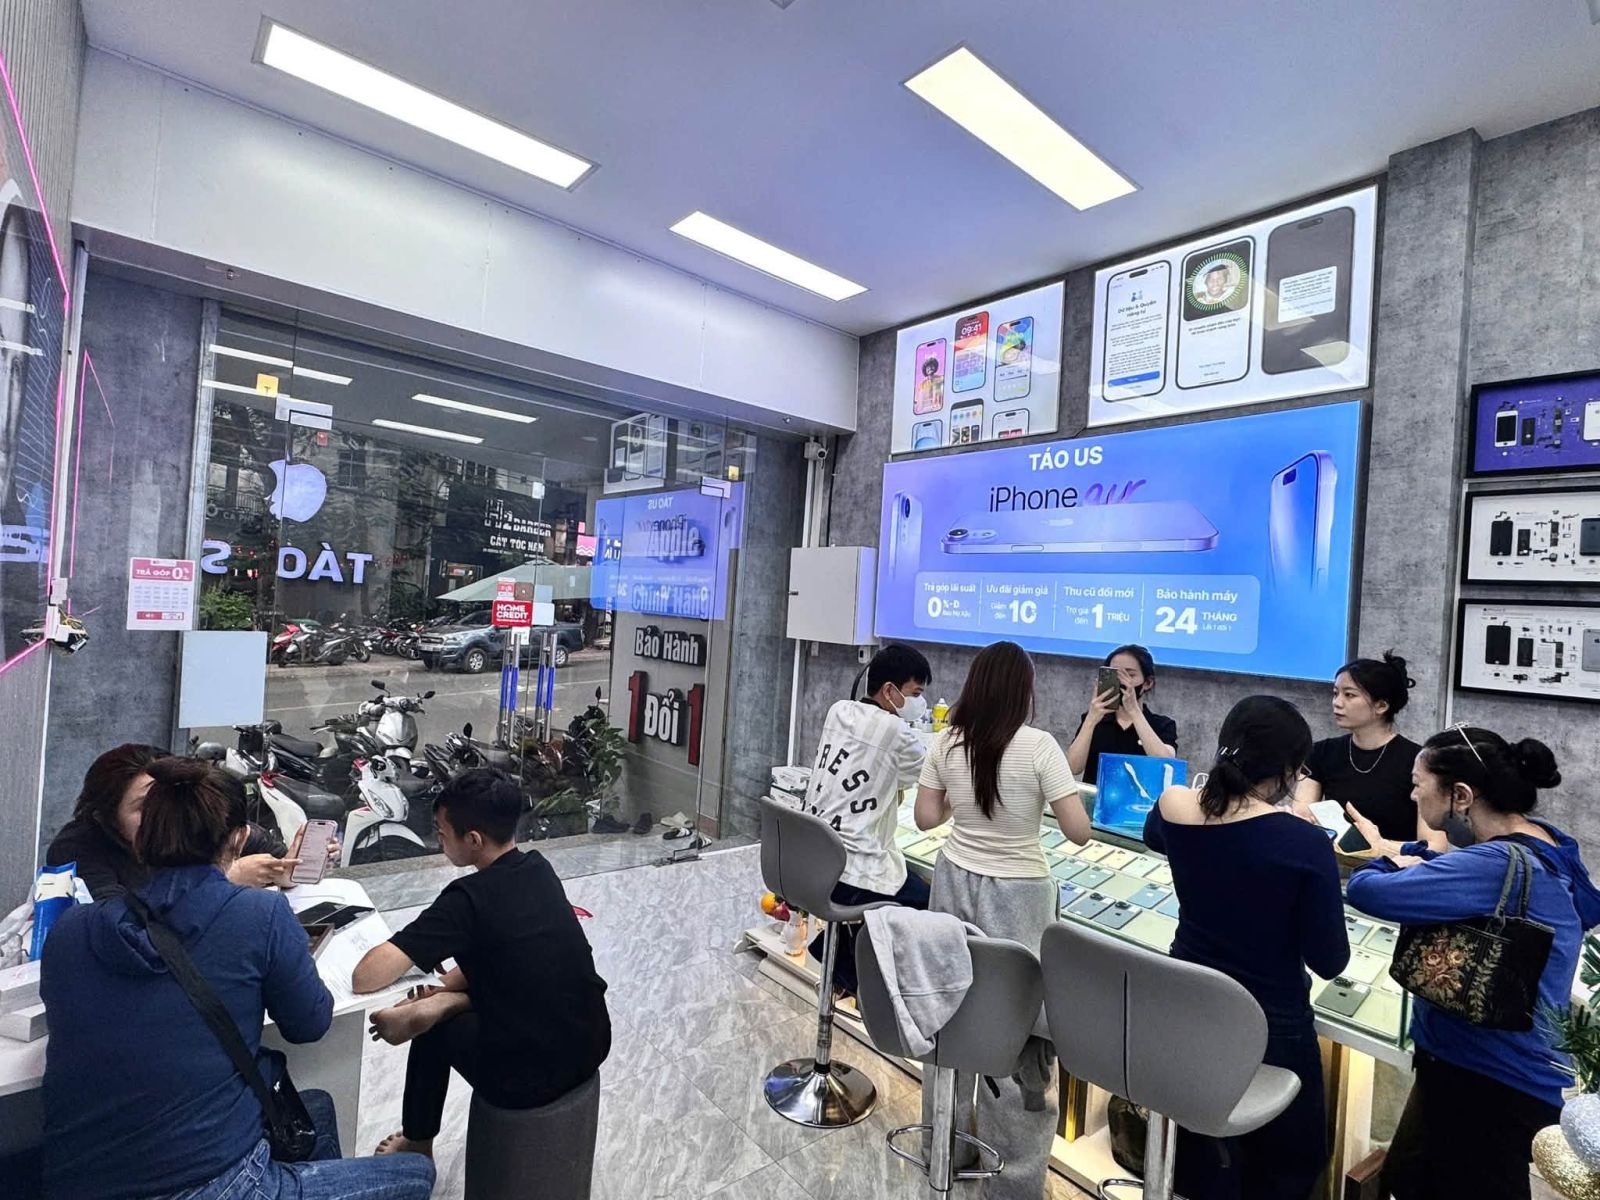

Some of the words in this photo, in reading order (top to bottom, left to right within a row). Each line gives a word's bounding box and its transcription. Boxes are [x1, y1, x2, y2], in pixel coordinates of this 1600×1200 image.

[1029, 447, 1069, 471] TÁO
[1074, 446, 1103, 466] US
[989, 485, 1078, 512] iPhone
[1064, 586, 1082, 597] Thu
[1083, 587, 1096, 597] cũ
[1097, 587, 1113, 597] đổi
[1114, 588, 1134, 598] mới
[1156, 588, 1178, 600] Bảo
[1179, 589, 1209, 601] hành
[1212, 590, 1238, 604] máy
[496, 611, 528, 619] CREDIT
[497, 604, 525, 612] HOME
[928, 596, 942, 618] 0
[1091, 603, 1104, 629] 1
[1107, 612, 1130, 623] TRIỆU
[1155, 606, 1198, 635] 24
[1202, 611, 1238, 623] THÁNG
[635, 626, 660, 658] Bảo
[663, 632, 699, 664] Hành
[628, 672, 640, 743] 1
[643, 690, 679, 744] Đổi
[687, 685, 705, 766] 1
[815, 744, 878, 814] RESS
